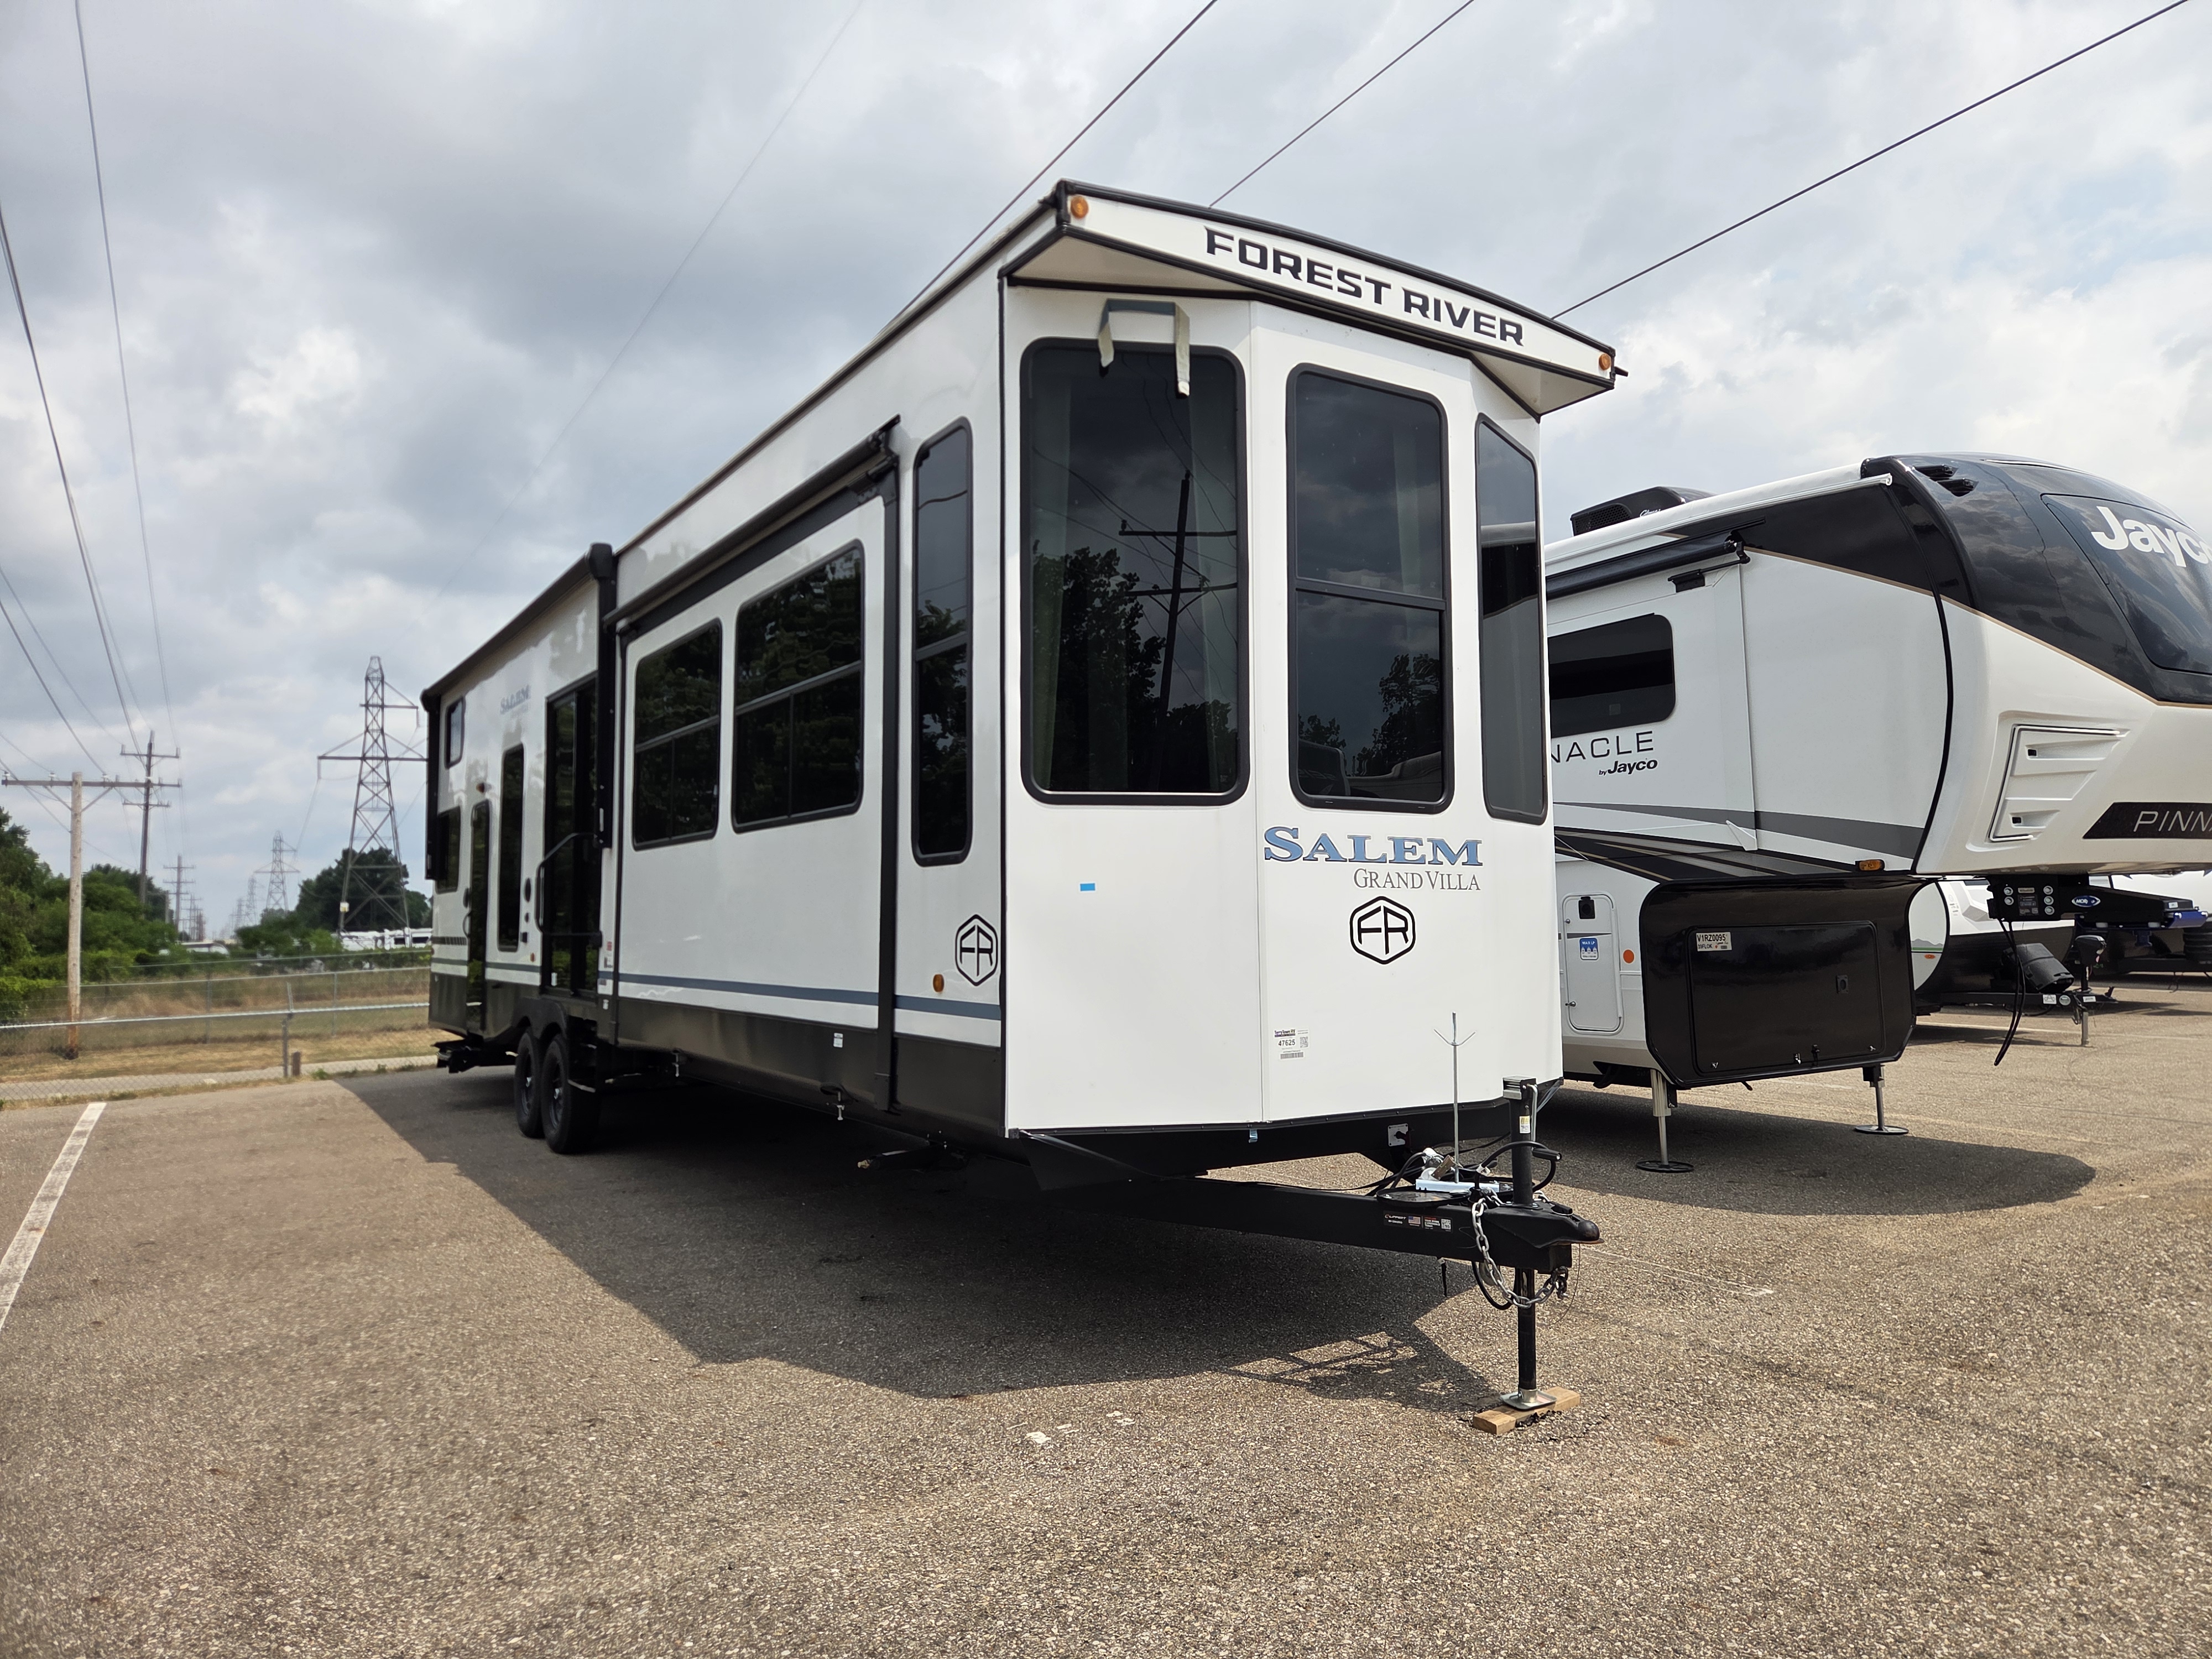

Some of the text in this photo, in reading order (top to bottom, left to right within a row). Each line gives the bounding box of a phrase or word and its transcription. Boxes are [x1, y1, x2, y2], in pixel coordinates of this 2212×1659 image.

[1204, 226, 1524, 347] FOREST RIVER
[1608, 759, 1658, 775] Jayco
[2133, 811, 2212, 832] PINN
[1264, 826, 1483, 867] SALEM
[1353, 868, 1481, 891] GRAND VILLA
